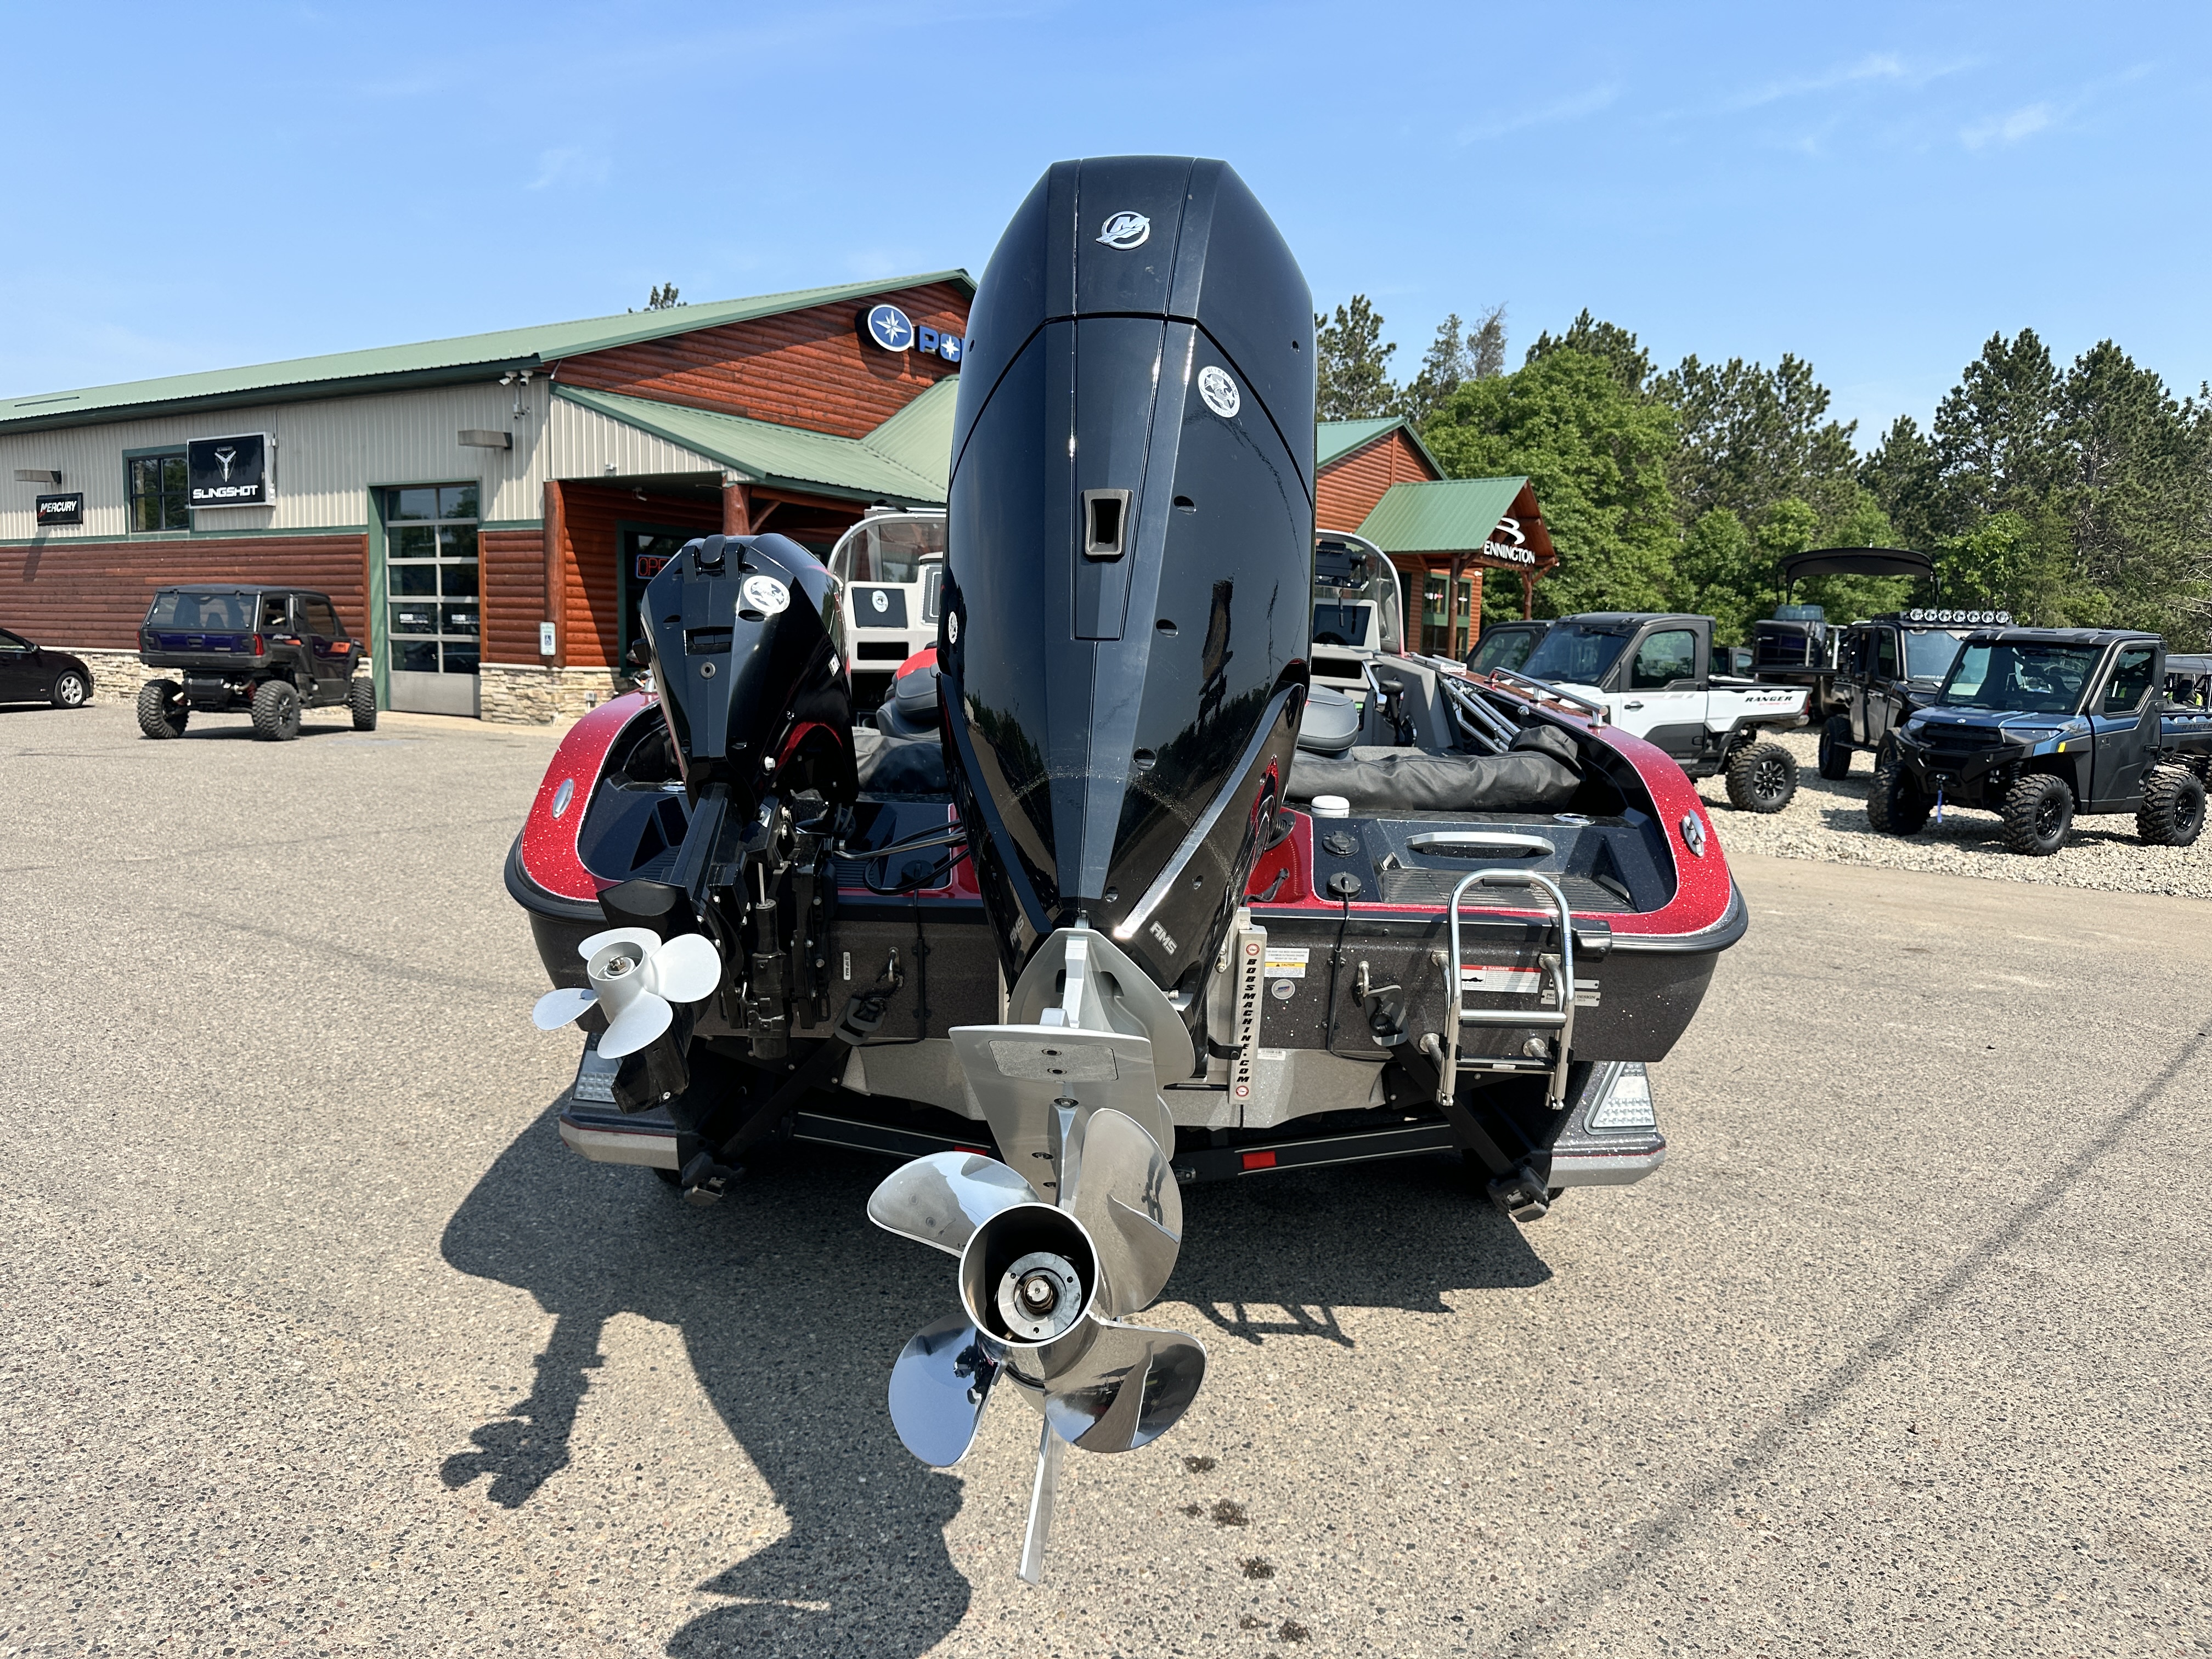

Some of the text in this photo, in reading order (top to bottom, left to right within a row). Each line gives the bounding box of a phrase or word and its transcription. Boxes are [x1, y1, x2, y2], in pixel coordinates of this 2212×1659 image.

[918, 325, 965, 363] PO
[193, 484, 258, 500] SLINGSHOT
[40, 500, 77, 514] MERCURY
[1483, 540, 1536, 565] ENNINGTON
[639, 557, 668, 577] OPE
[1149, 921, 1178, 956] AMS
[1237, 958, 1257, 1083] BOBSMACHINE.COM
